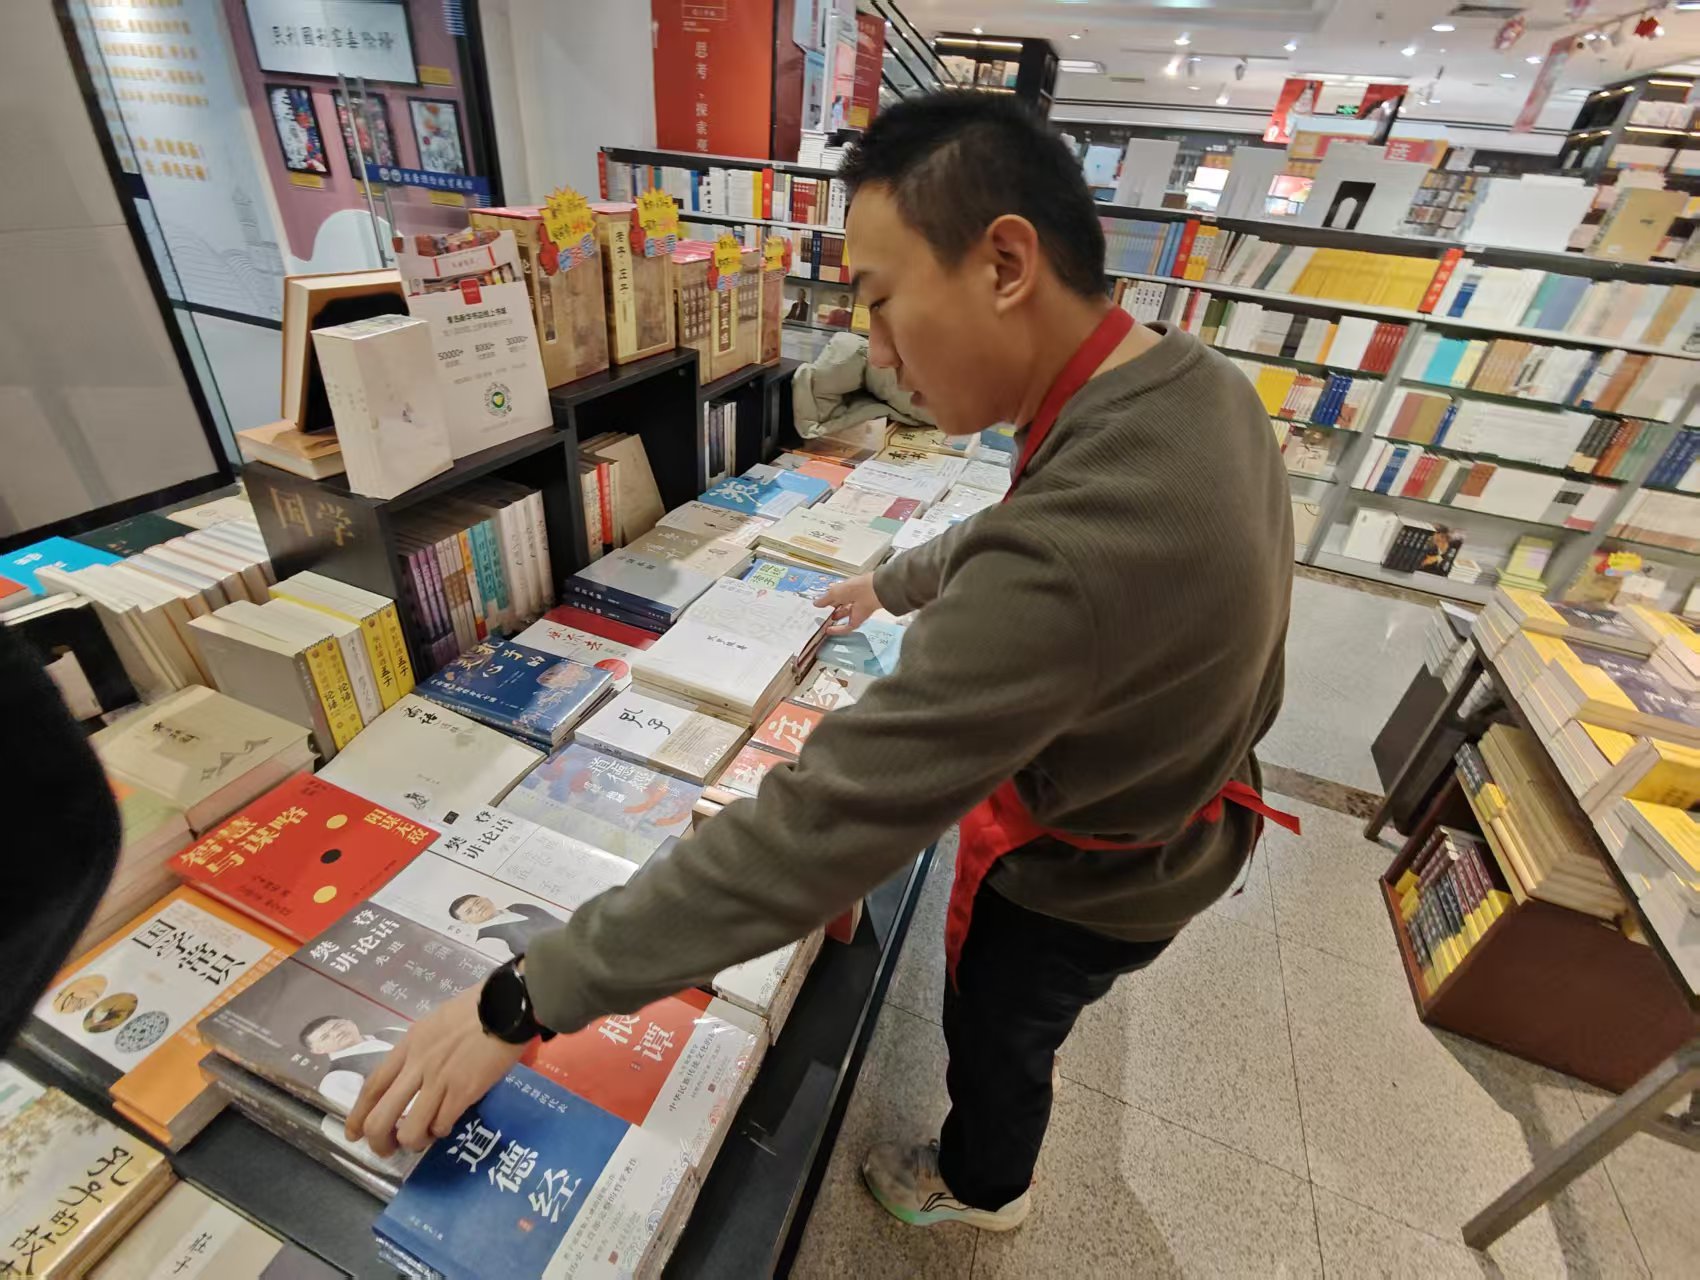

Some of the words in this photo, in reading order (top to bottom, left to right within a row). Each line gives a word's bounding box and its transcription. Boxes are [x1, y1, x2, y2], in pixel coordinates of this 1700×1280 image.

[206, 805, 308, 878] 与谋略
[363, 808, 430, 845] 阳谋无敌
[462, 812, 514, 861] 讲论语
[131, 918, 246, 985] 国学常识
[309, 908, 379, 963] 樊登
[329, 918, 400, 973] 讲论语
[446, 1117, 583, 1223] 道德经
